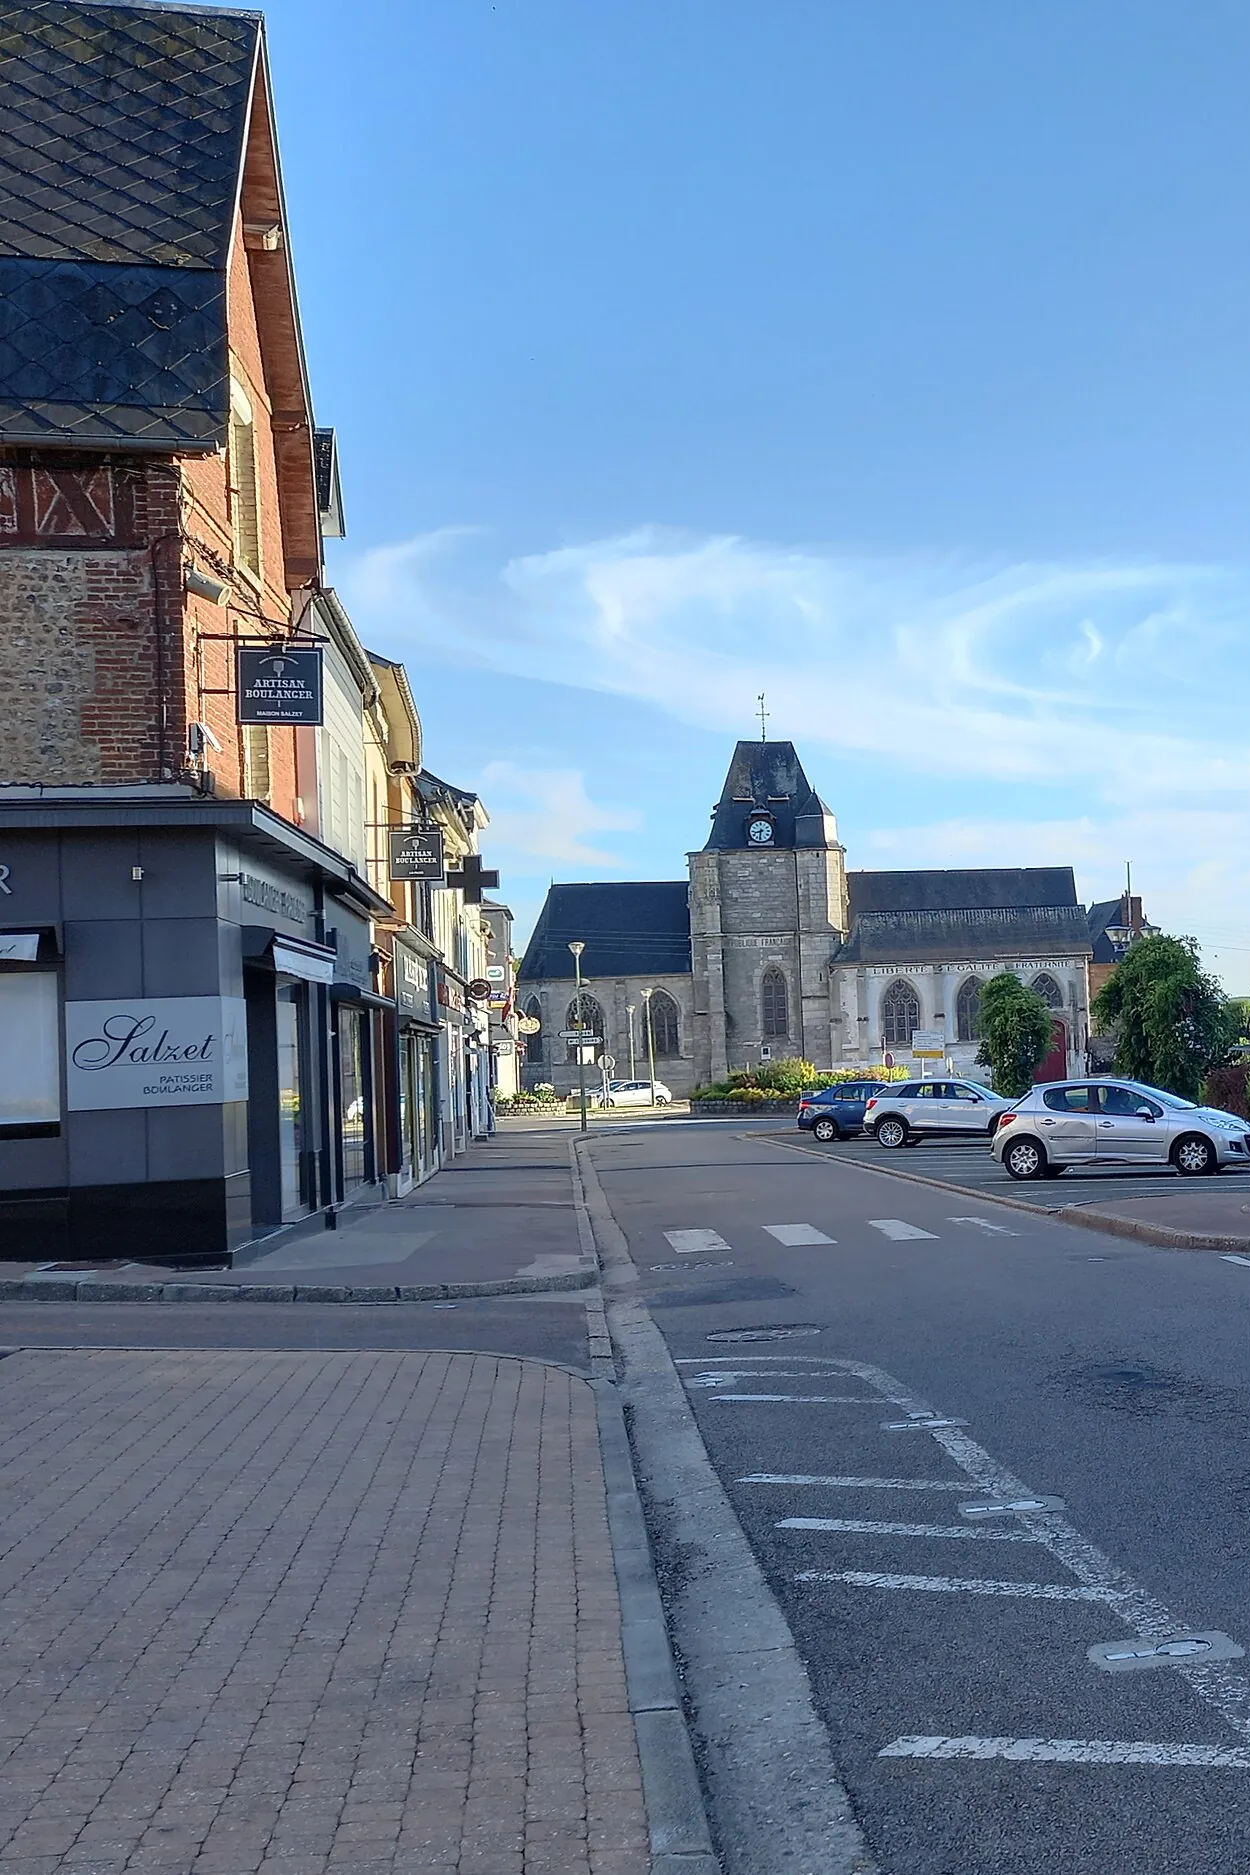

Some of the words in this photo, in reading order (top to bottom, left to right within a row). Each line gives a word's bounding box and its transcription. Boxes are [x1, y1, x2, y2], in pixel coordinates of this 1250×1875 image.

[253, 679, 306, 689] ARTISAN
[245, 689, 314, 699] BOULANGER
[72, 1014, 218, 1071] Salzet
[159, 1074, 213, 1084] PATISSIER
[143, 1083, 213, 1094] BOULANGER
